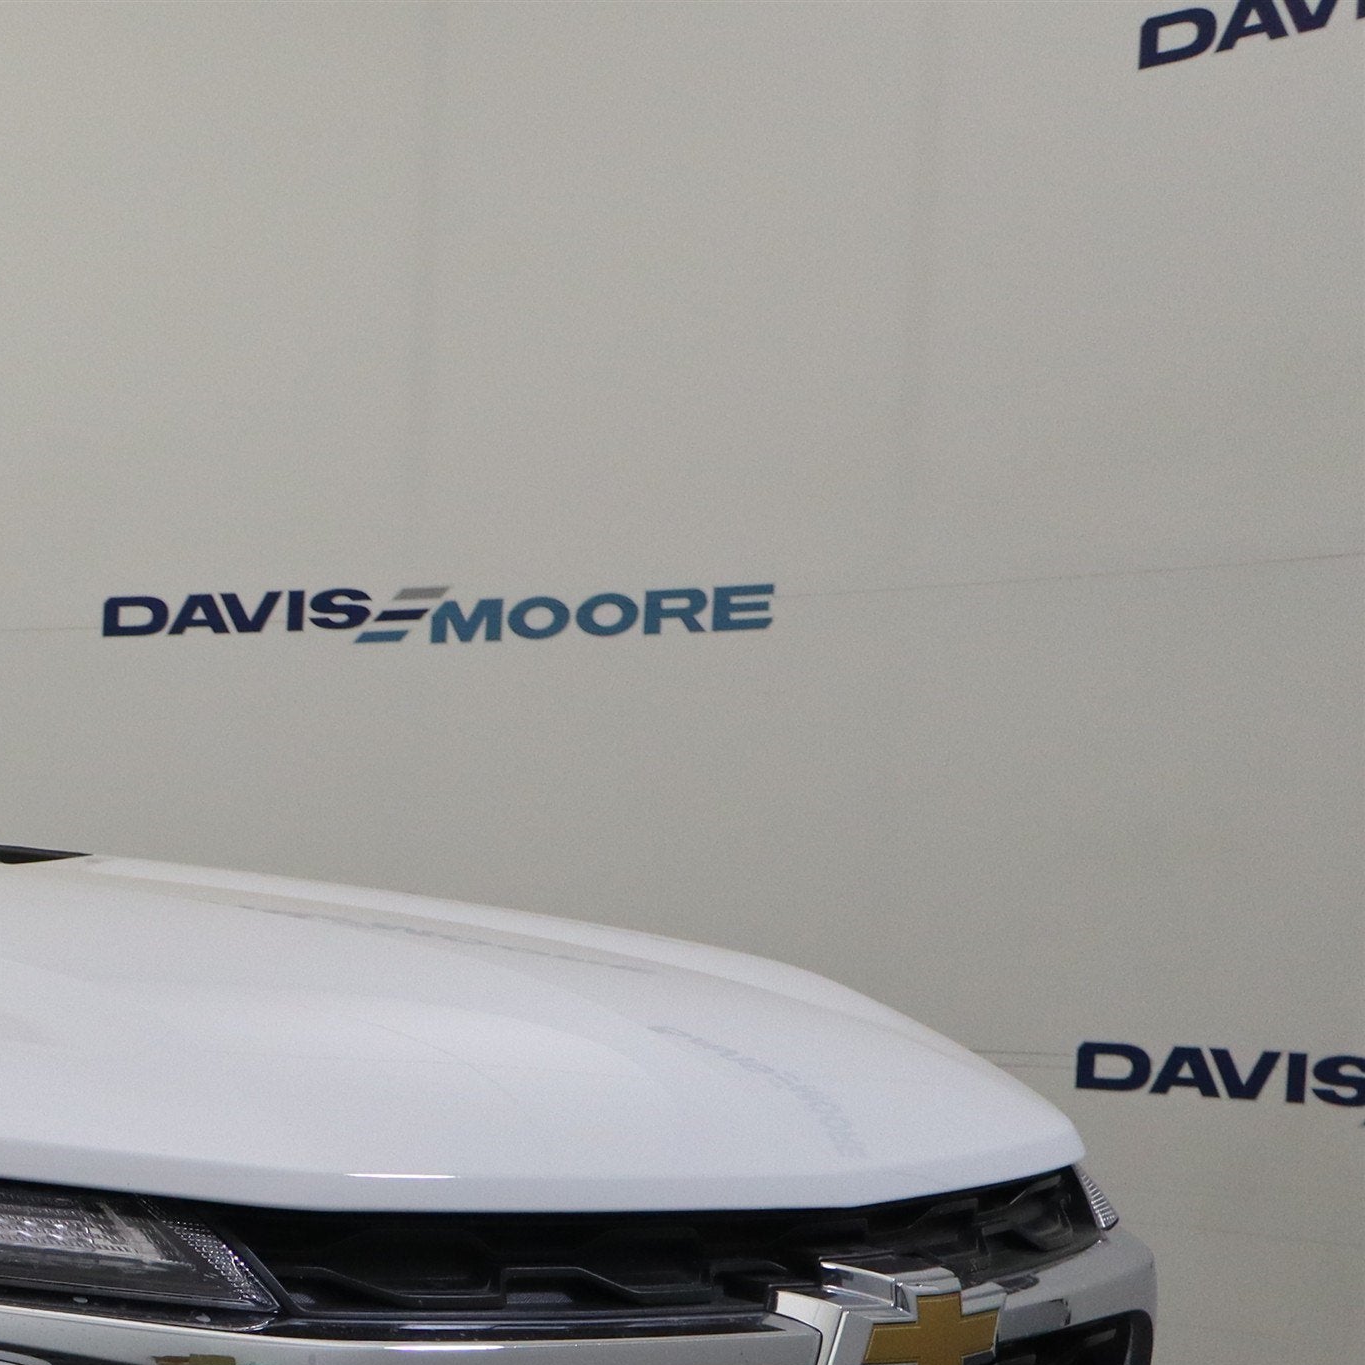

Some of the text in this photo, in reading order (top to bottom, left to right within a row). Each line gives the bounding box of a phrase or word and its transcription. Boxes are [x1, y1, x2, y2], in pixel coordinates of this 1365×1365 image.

[1138, 0, 1365, 70] DAV
[101, 583, 775, 645] DAVIS MOORE
[1075, 1041, 1365, 1108] DAVIS
